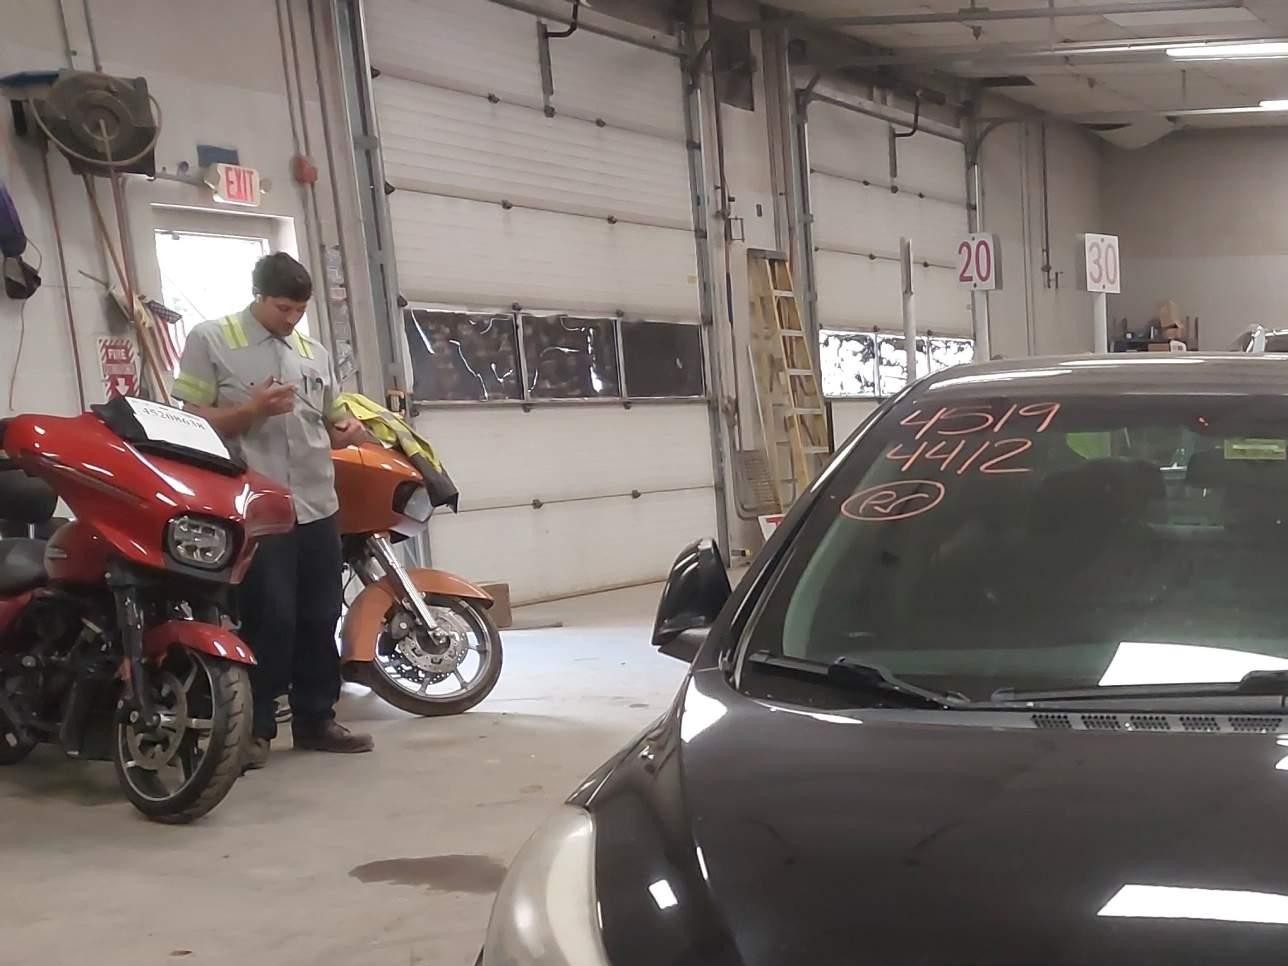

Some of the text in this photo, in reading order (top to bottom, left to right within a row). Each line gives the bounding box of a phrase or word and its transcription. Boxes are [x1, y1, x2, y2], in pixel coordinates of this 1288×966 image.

[225, 166, 255, 202] EXIT
[958, 239, 991, 282] 20
[1088, 242, 1118, 285] 30
[900, 402, 1061, 440] 4519
[886, 438, 1033, 475] 4412
